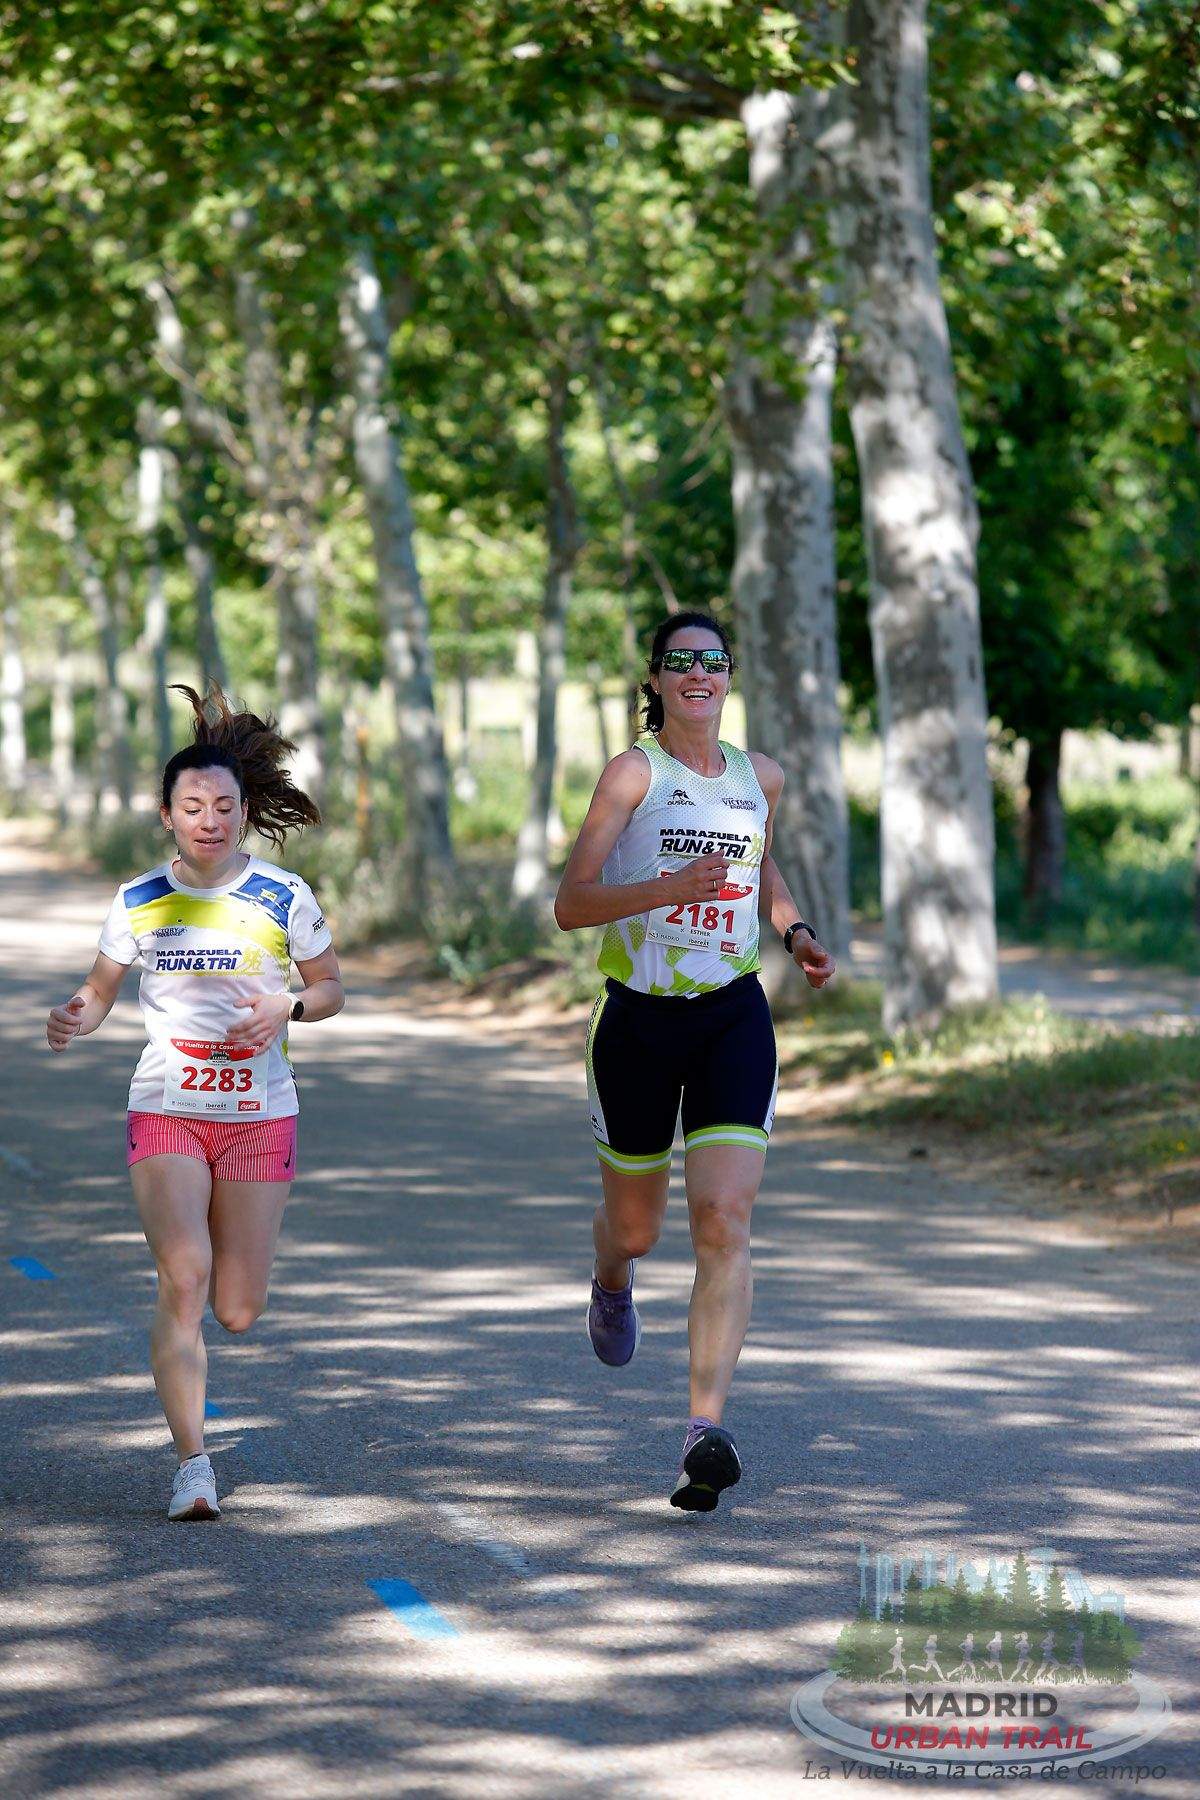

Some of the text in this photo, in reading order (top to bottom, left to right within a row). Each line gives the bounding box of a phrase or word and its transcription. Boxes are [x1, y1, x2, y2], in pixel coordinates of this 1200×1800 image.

[660, 829, 751, 842] MARAZUELA
[665, 903, 735, 933] 2181
[690, 929, 711, 937] ESTHER
[156, 949, 243, 957] MARAZUELA
[180, 1066, 253, 1092] 2283
